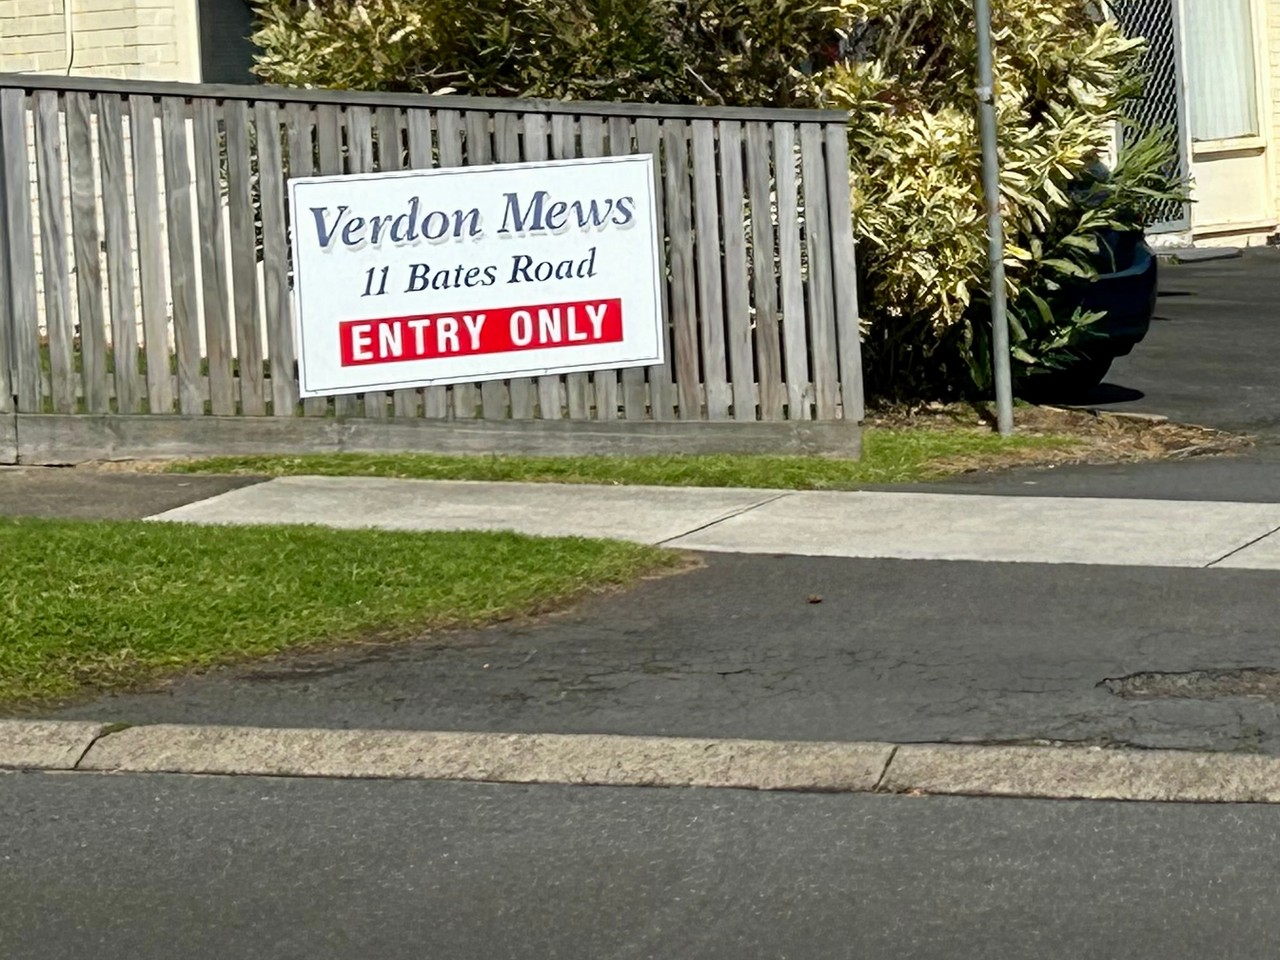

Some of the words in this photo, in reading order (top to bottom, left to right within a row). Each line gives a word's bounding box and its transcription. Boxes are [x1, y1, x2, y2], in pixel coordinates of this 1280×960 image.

[309, 196, 482, 249] Verdon
[497, 190, 636, 234] Mews
[360, 266, 389, 297] 11
[404, 263, 497, 293] Bates
[507, 247, 598, 284] Road
[350, 314, 487, 361] ENTRY
[509, 303, 609, 347] ONLY
